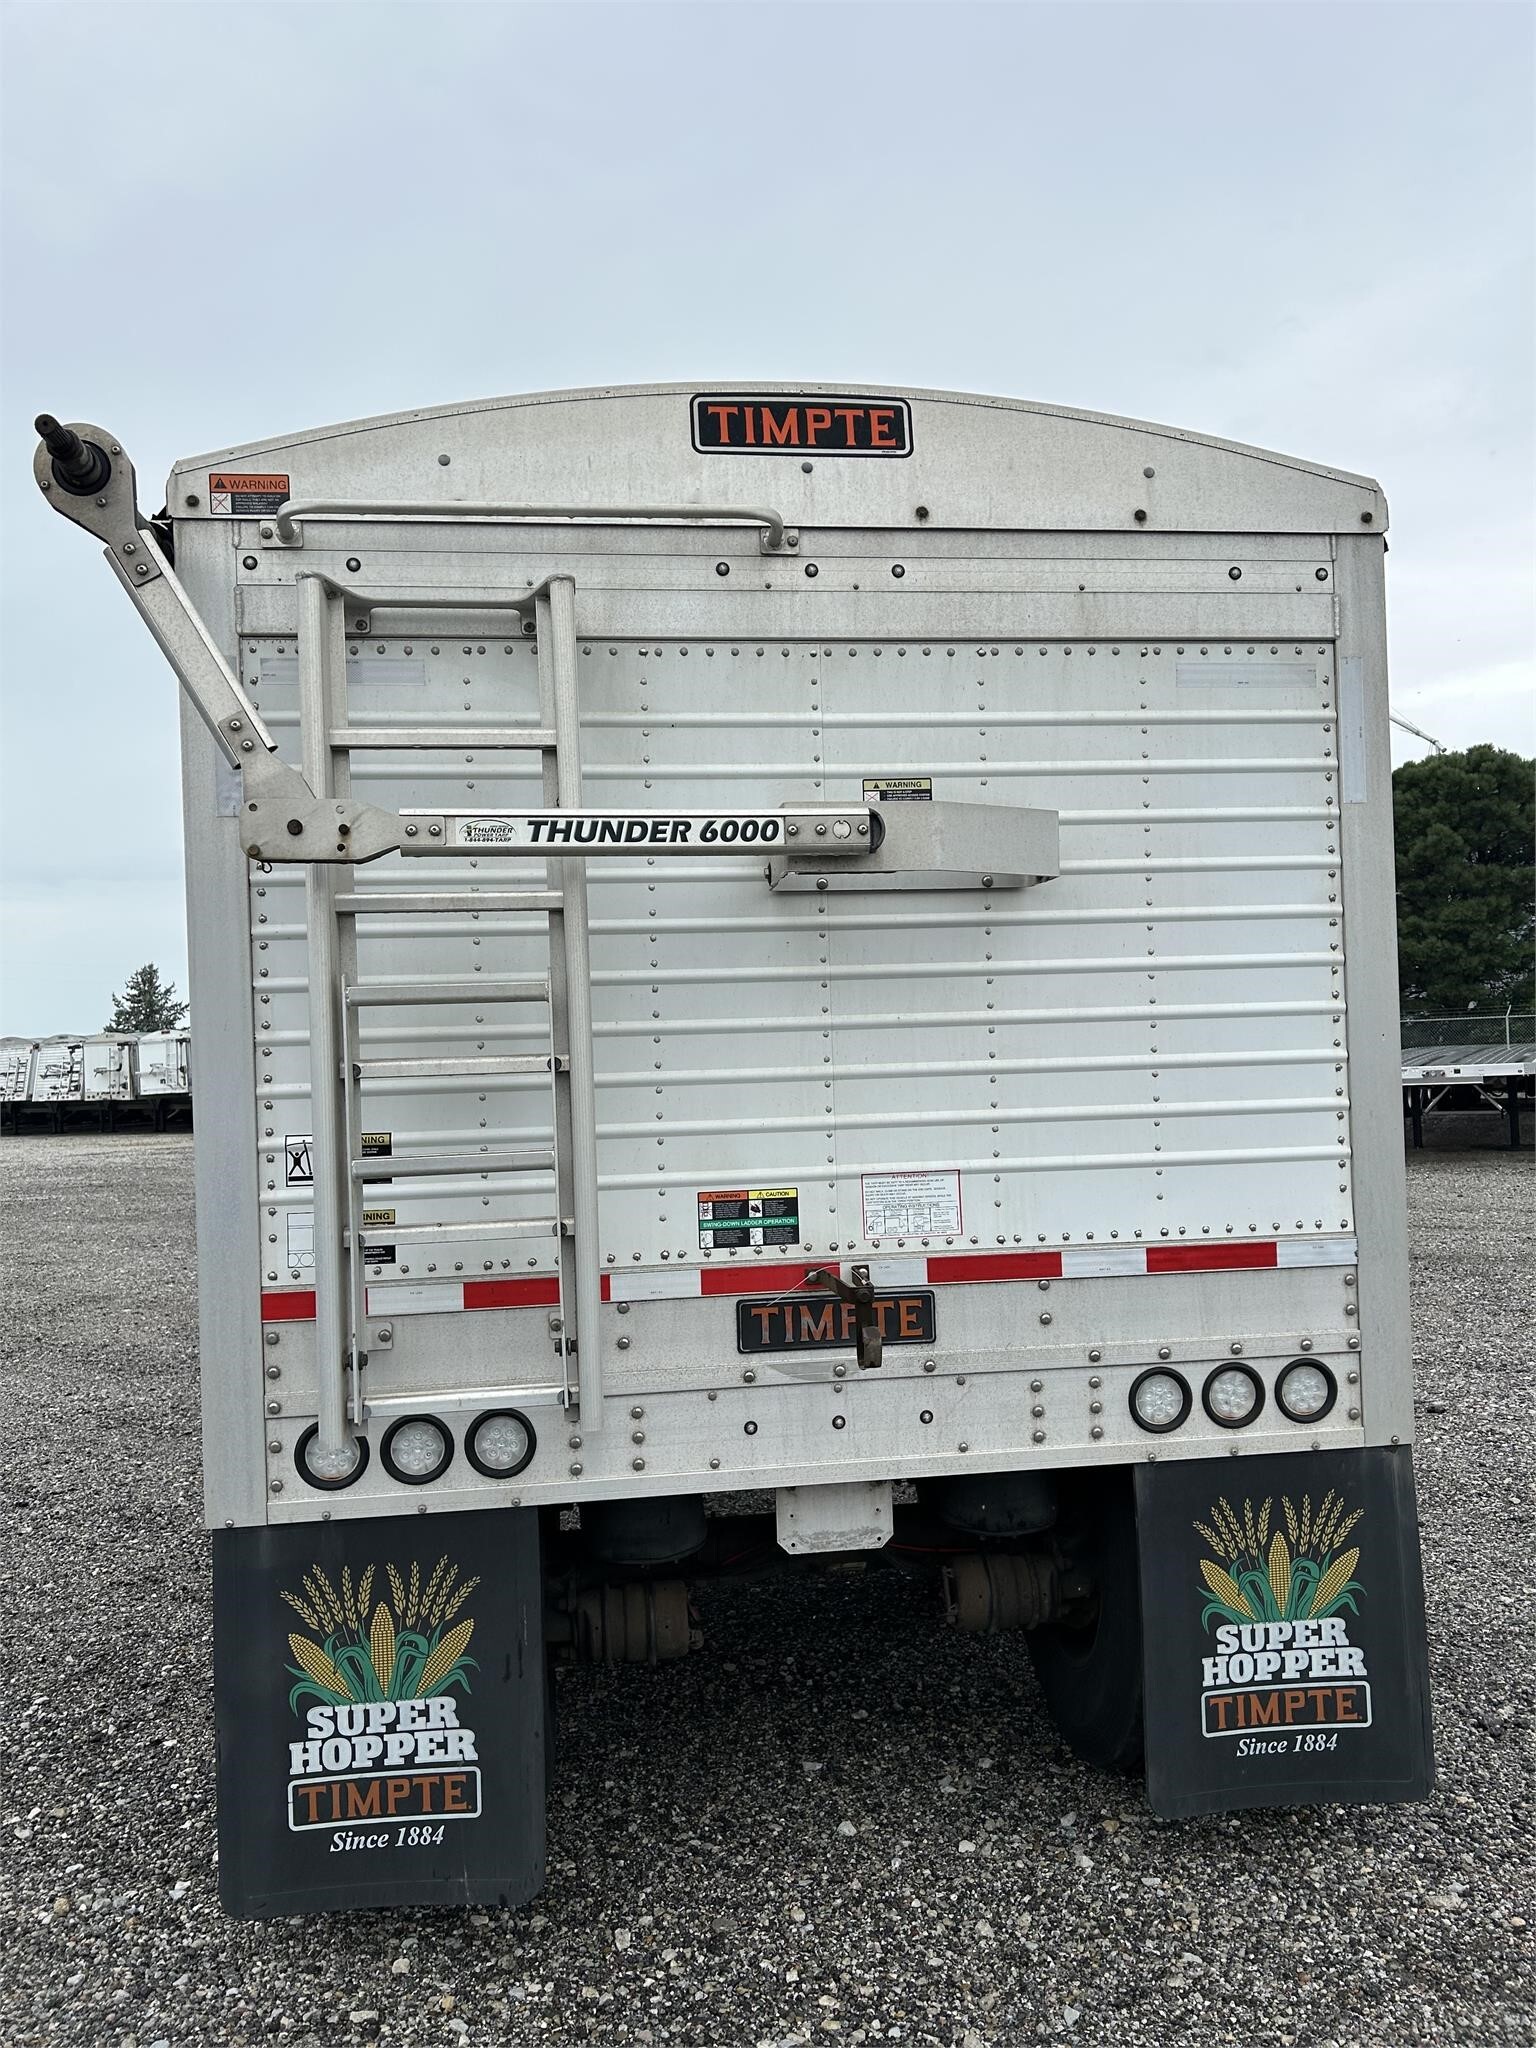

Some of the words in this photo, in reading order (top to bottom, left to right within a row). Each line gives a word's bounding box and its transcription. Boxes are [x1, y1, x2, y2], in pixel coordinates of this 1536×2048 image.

[707, 406, 897, 446] TIMPTE
[229, 480, 287, 490] WARNING
[527, 820, 692, 843] THUNDER
[699, 819, 780, 843] 6000
[361, 1136, 385, 1144] NING
[363, 1212, 390, 1220] NING
[1215, 1617, 1349, 1654] SUPER
[1202, 1646, 1367, 1687] HOPPER
[306, 1696, 460, 1739] SUPER
[288, 1728, 479, 1775] HOPPER
[1236, 1738, 1288, 1757] Since
[1293, 1733, 1338, 1752] 1884
[330, 1832, 389, 1852] Since
[395, 1825, 445, 1847] 1884
